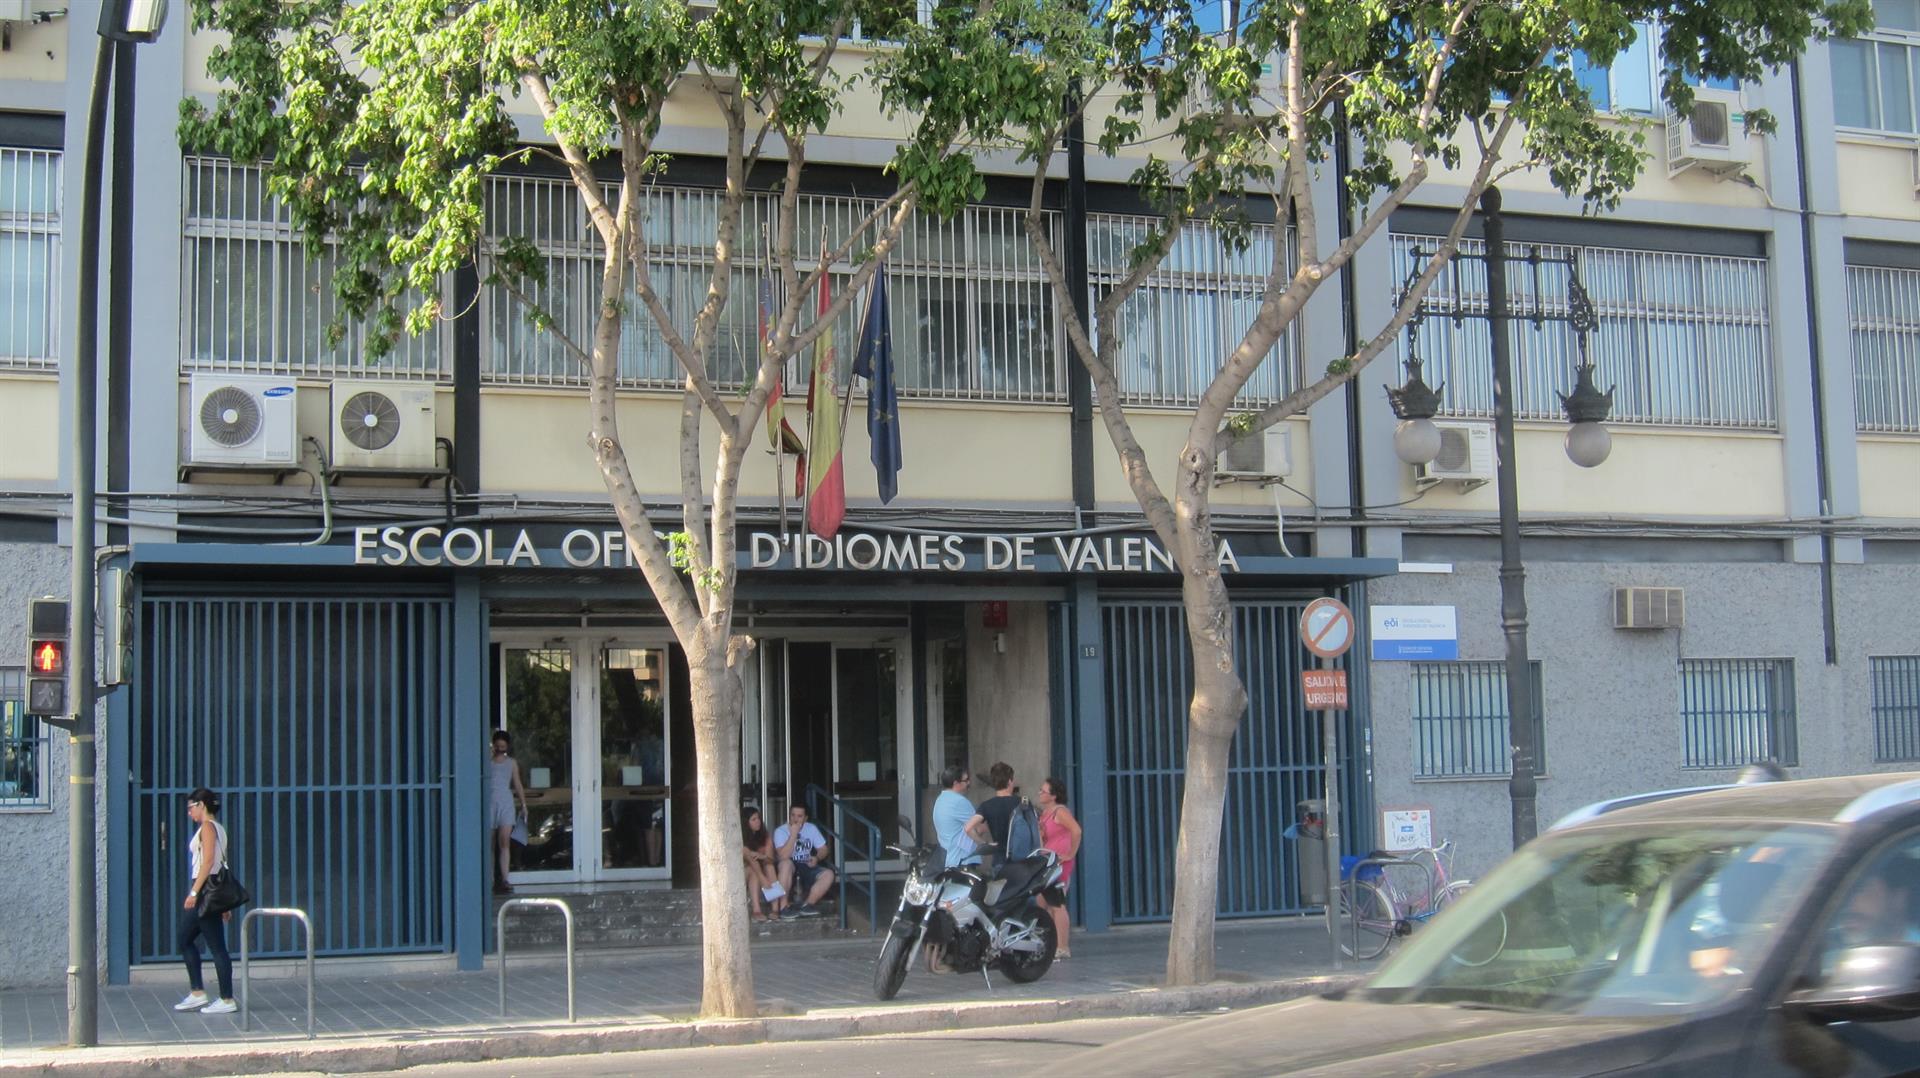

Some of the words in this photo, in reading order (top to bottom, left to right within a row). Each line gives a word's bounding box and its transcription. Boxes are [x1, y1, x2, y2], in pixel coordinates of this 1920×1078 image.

[354, 526, 541, 567] ESCOLA
[750, 533, 965, 571] D'IDIOMES
[984, 536, 1035, 571] DE
[1053, 536, 1241, 573] VALENA
[1085, 647, 1095, 657] 19
